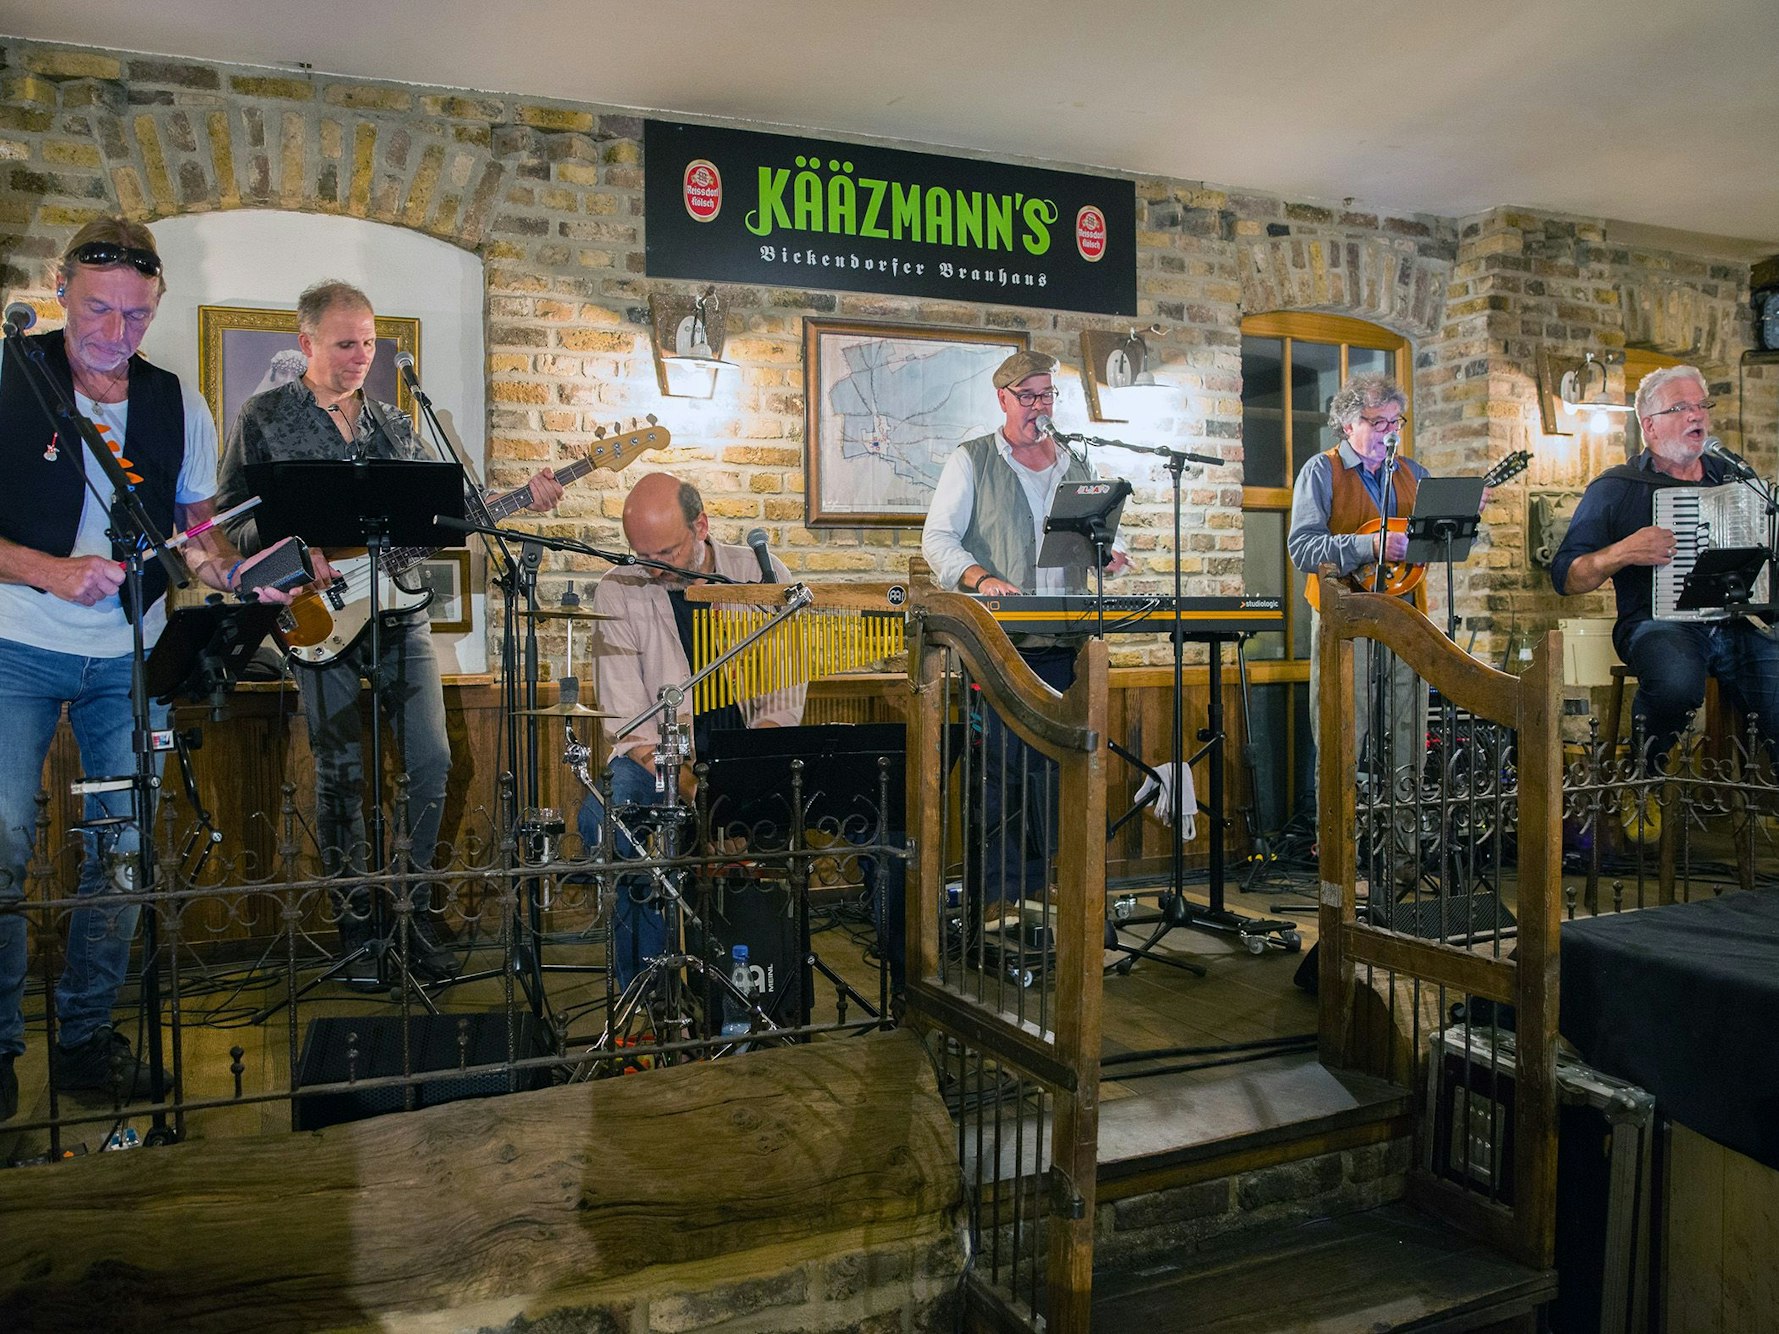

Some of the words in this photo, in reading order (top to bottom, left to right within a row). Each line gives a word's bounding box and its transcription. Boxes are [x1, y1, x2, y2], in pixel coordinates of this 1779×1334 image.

[745, 155, 1058, 255] KÄÄZMANN'S
[760, 245, 925, 277] Bickendorfer
[939, 262, 1047, 287] Brauhaus
[1245, 600, 1279, 609] studiologic
